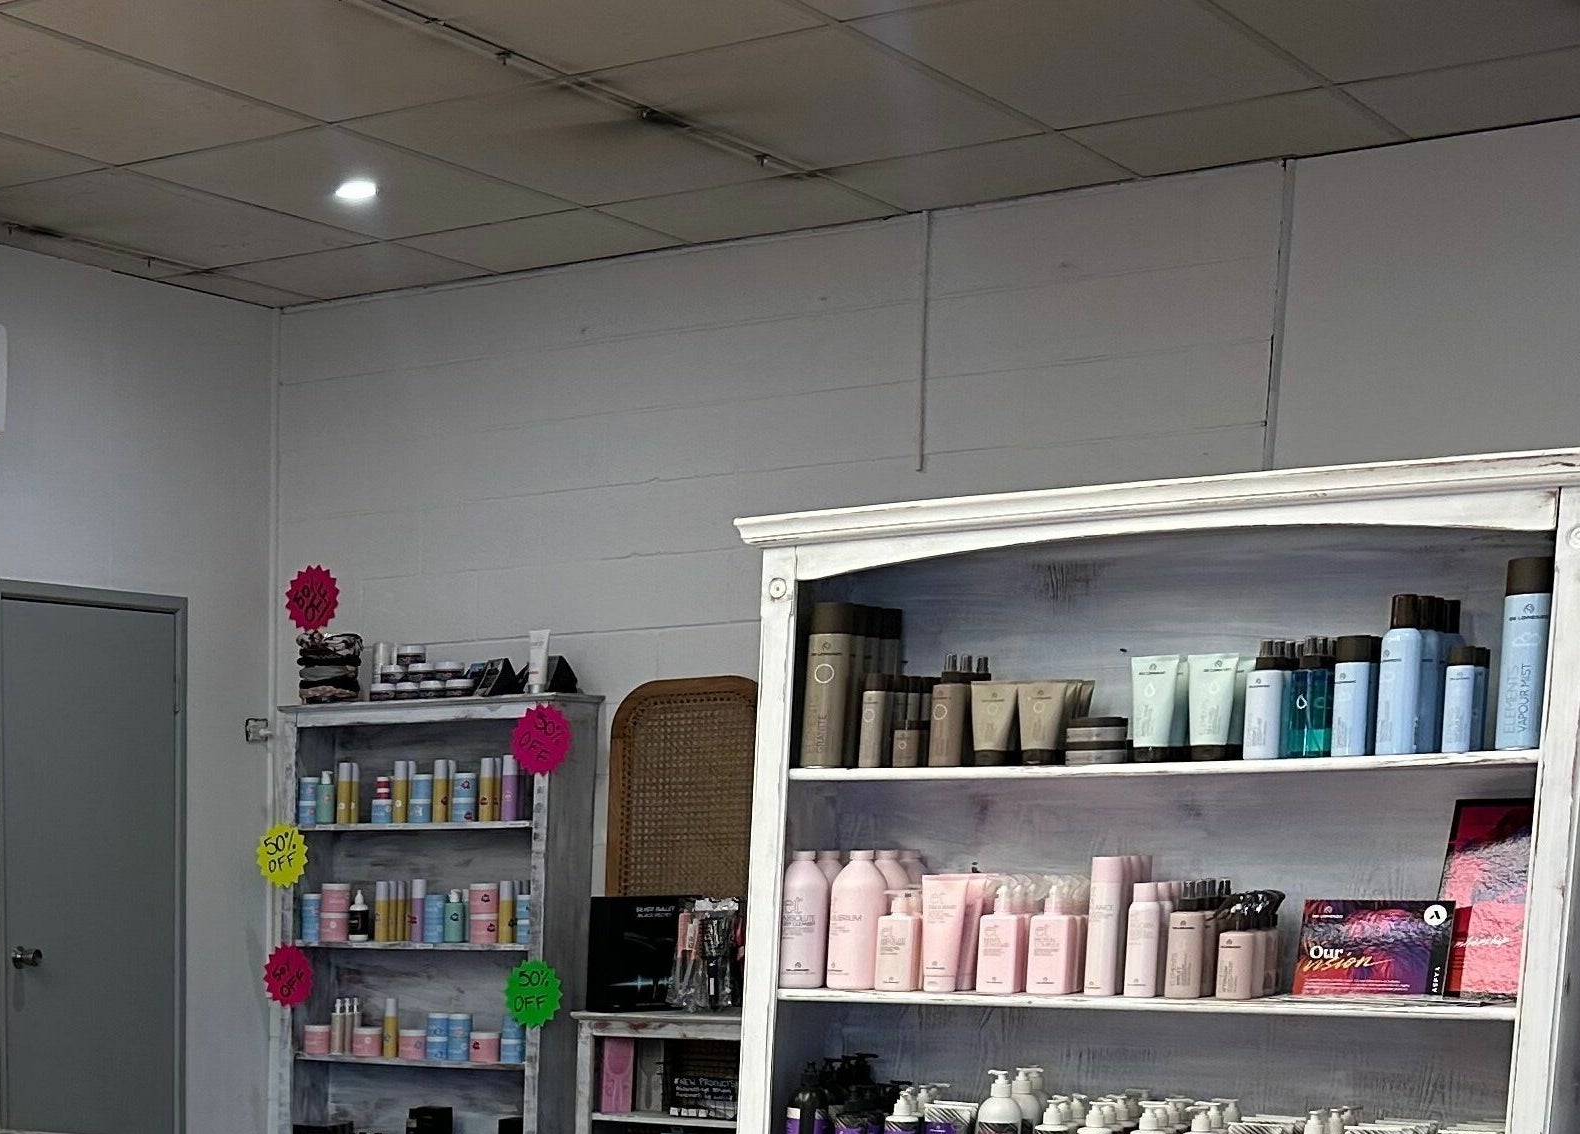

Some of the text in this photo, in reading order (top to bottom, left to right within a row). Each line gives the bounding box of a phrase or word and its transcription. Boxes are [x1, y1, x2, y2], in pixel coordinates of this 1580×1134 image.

[1517, 663, 1532, 733] VAPOUR MIST
[264, 830, 296, 856] 50%
[268, 851, 296, 873] OFF
[1309, 945, 1344, 959] Our
[519, 970, 549, 987] 50%
[514, 993, 548, 1012] OFF
